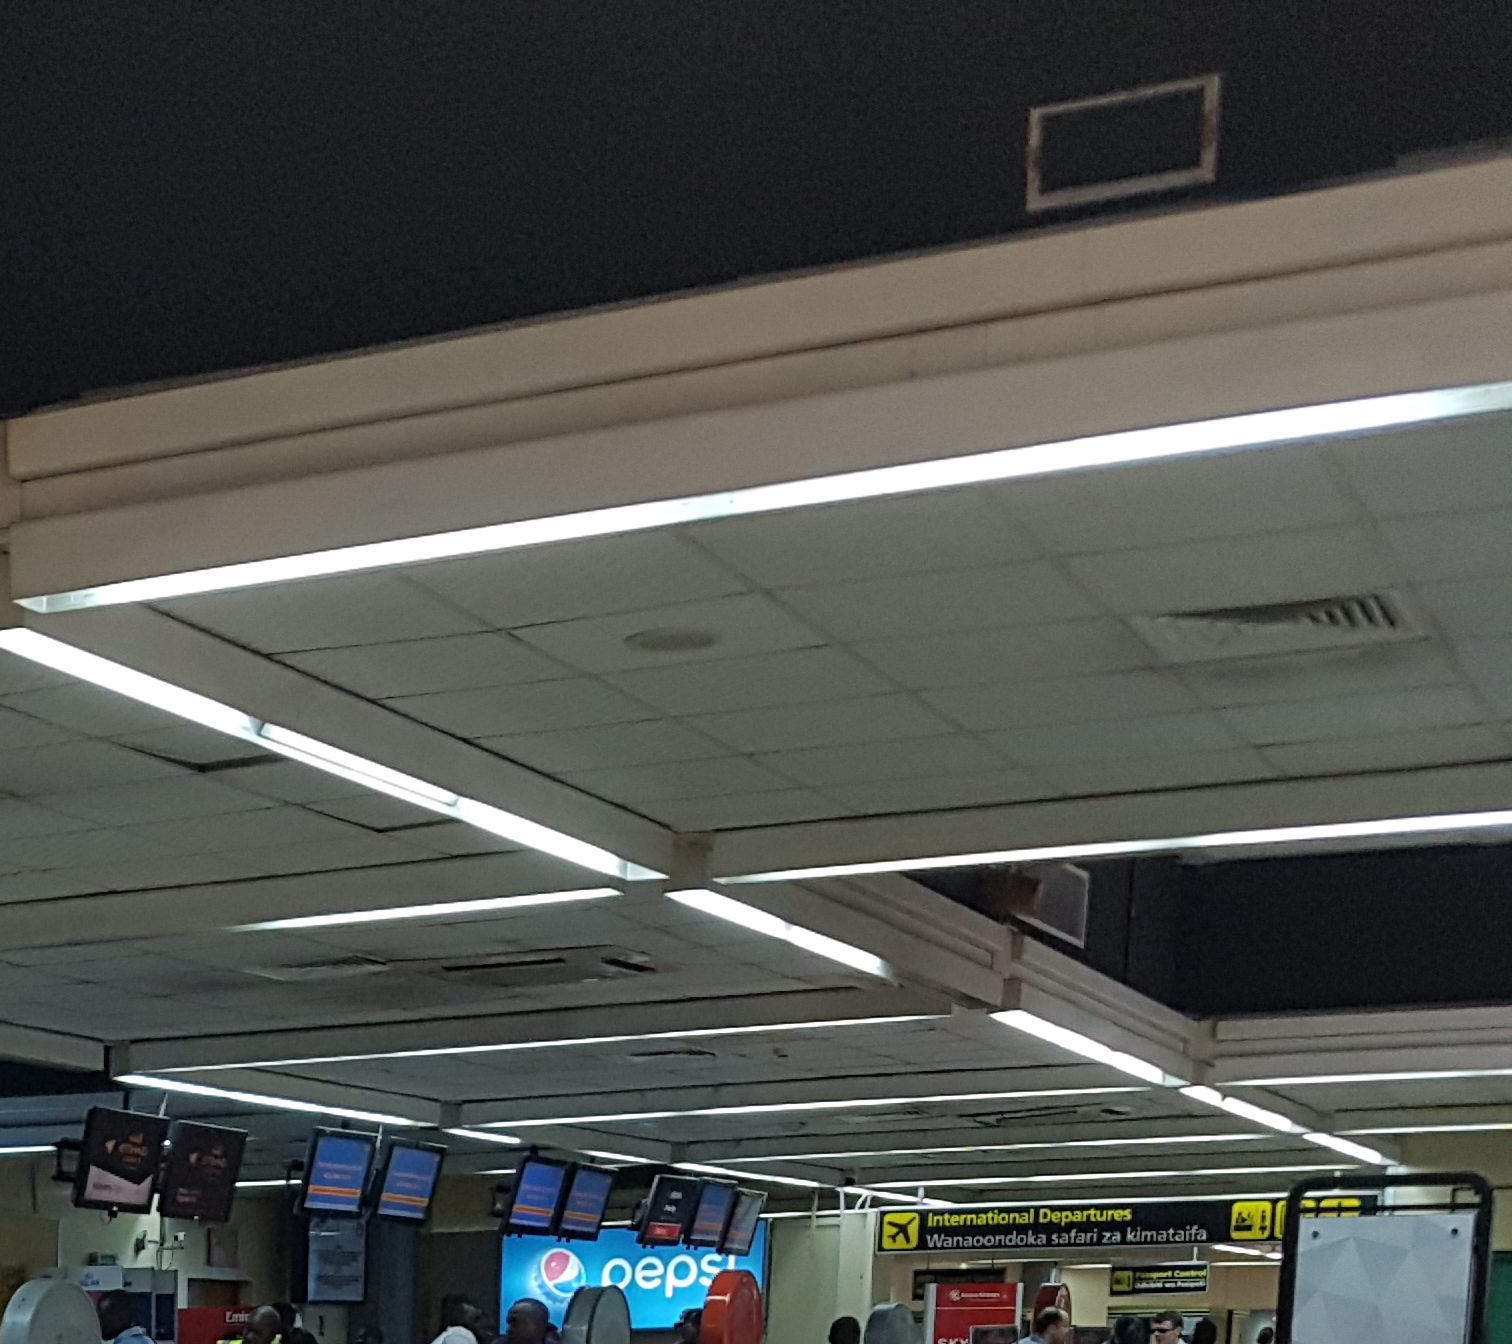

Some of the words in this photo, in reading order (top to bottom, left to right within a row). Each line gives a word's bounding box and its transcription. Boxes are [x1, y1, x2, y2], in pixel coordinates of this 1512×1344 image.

[926, 1208, 1035, 1228] International
[1038, 1207, 1133, 1226] Departures
[925, 1230, 1047, 1249] Wanaoondoka
[1050, 1229, 1098, 1246] safari
[1101, 1231, 1121, 1245] za
[1125, 1223, 1208, 1244] kimataifa
[1173, 1268, 1207, 1278] Control
[225, 1311, 250, 1323] Emir
